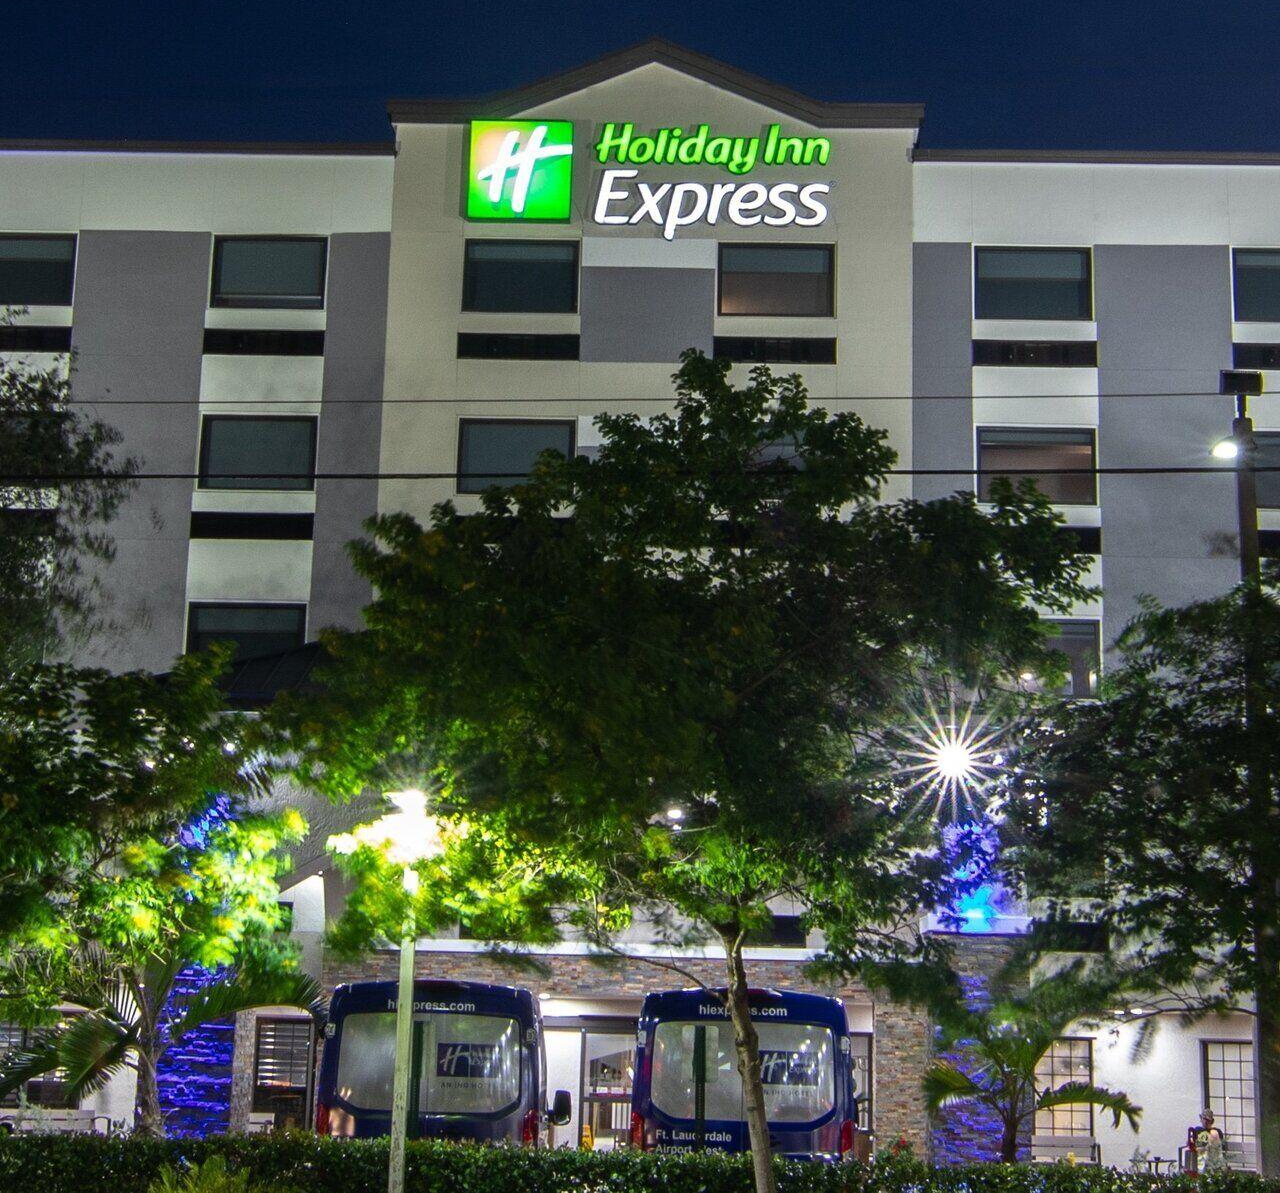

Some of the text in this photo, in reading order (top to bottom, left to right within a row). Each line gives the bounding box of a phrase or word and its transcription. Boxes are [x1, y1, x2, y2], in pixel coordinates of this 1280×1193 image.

[596, 122, 831, 175] Holiday Inn
[593, 169, 831, 242] Express
[387, 999, 475, 1012] hipress.com
[655, 1129, 669, 1140] Ft.
[655, 1143, 692, 1155] Airport
